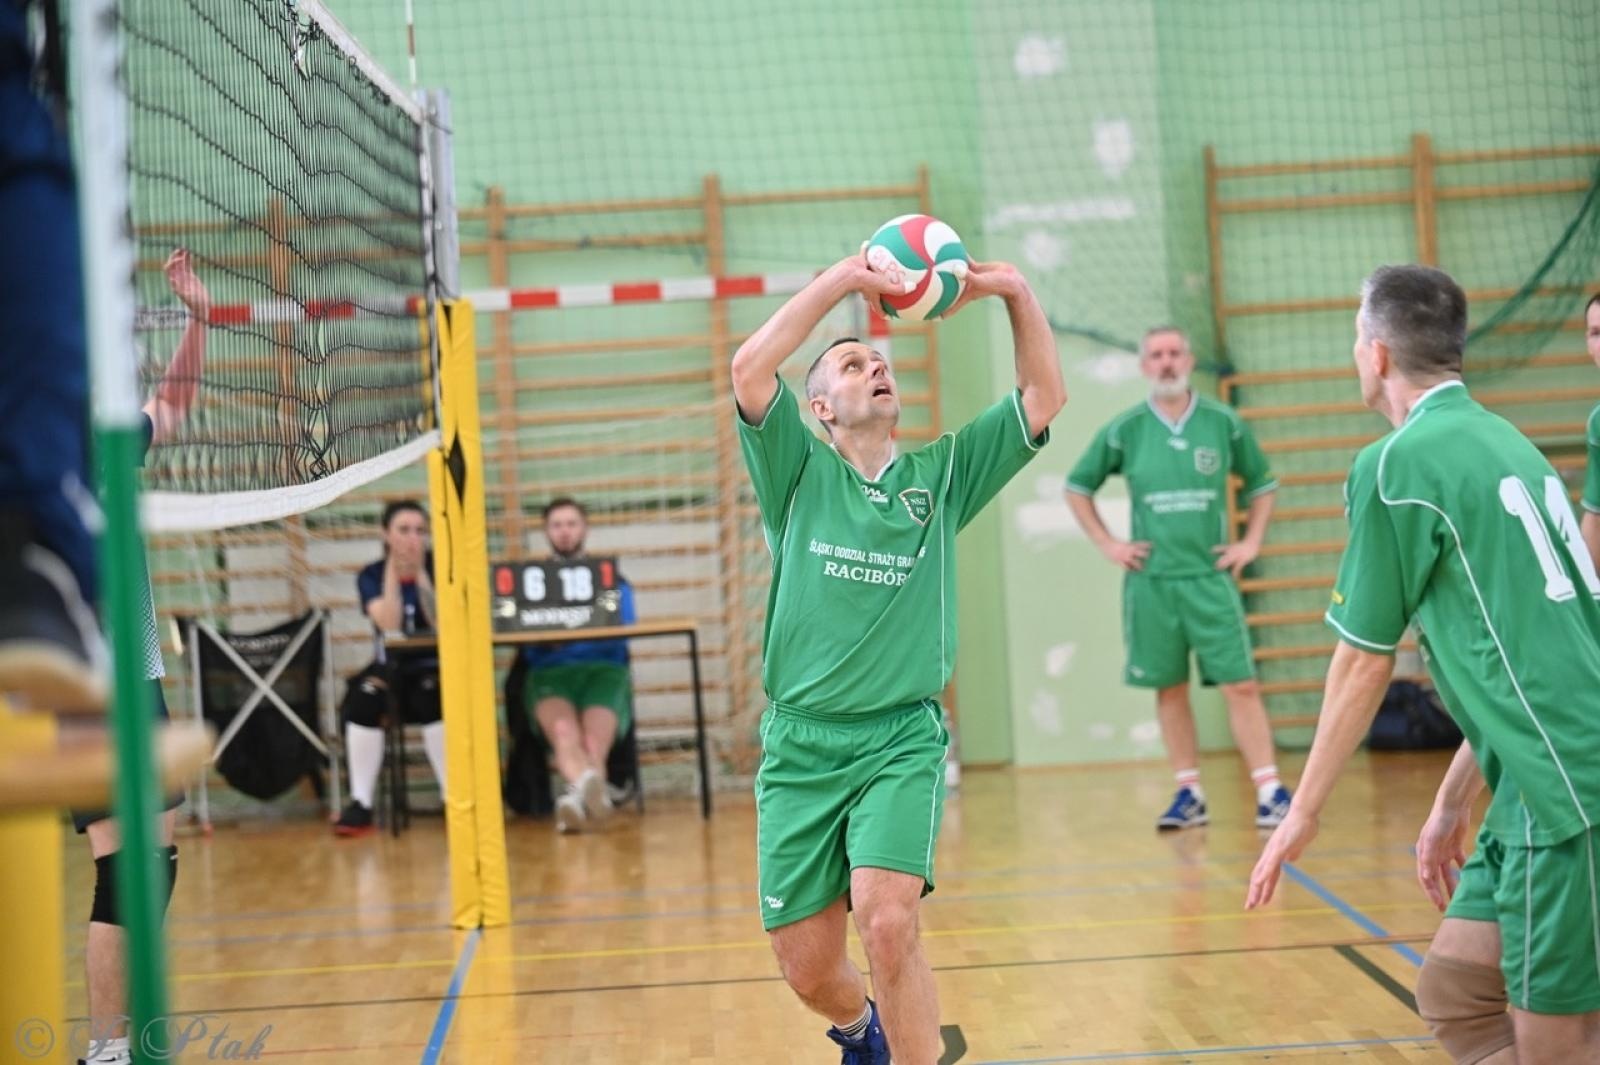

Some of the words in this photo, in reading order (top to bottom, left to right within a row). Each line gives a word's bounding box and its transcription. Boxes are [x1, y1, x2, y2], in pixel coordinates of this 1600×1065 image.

[809, 538, 833, 557] ŚLĄSKI
[523, 566, 546, 601] 6
[823, 560, 911, 586] RACIBÓR
